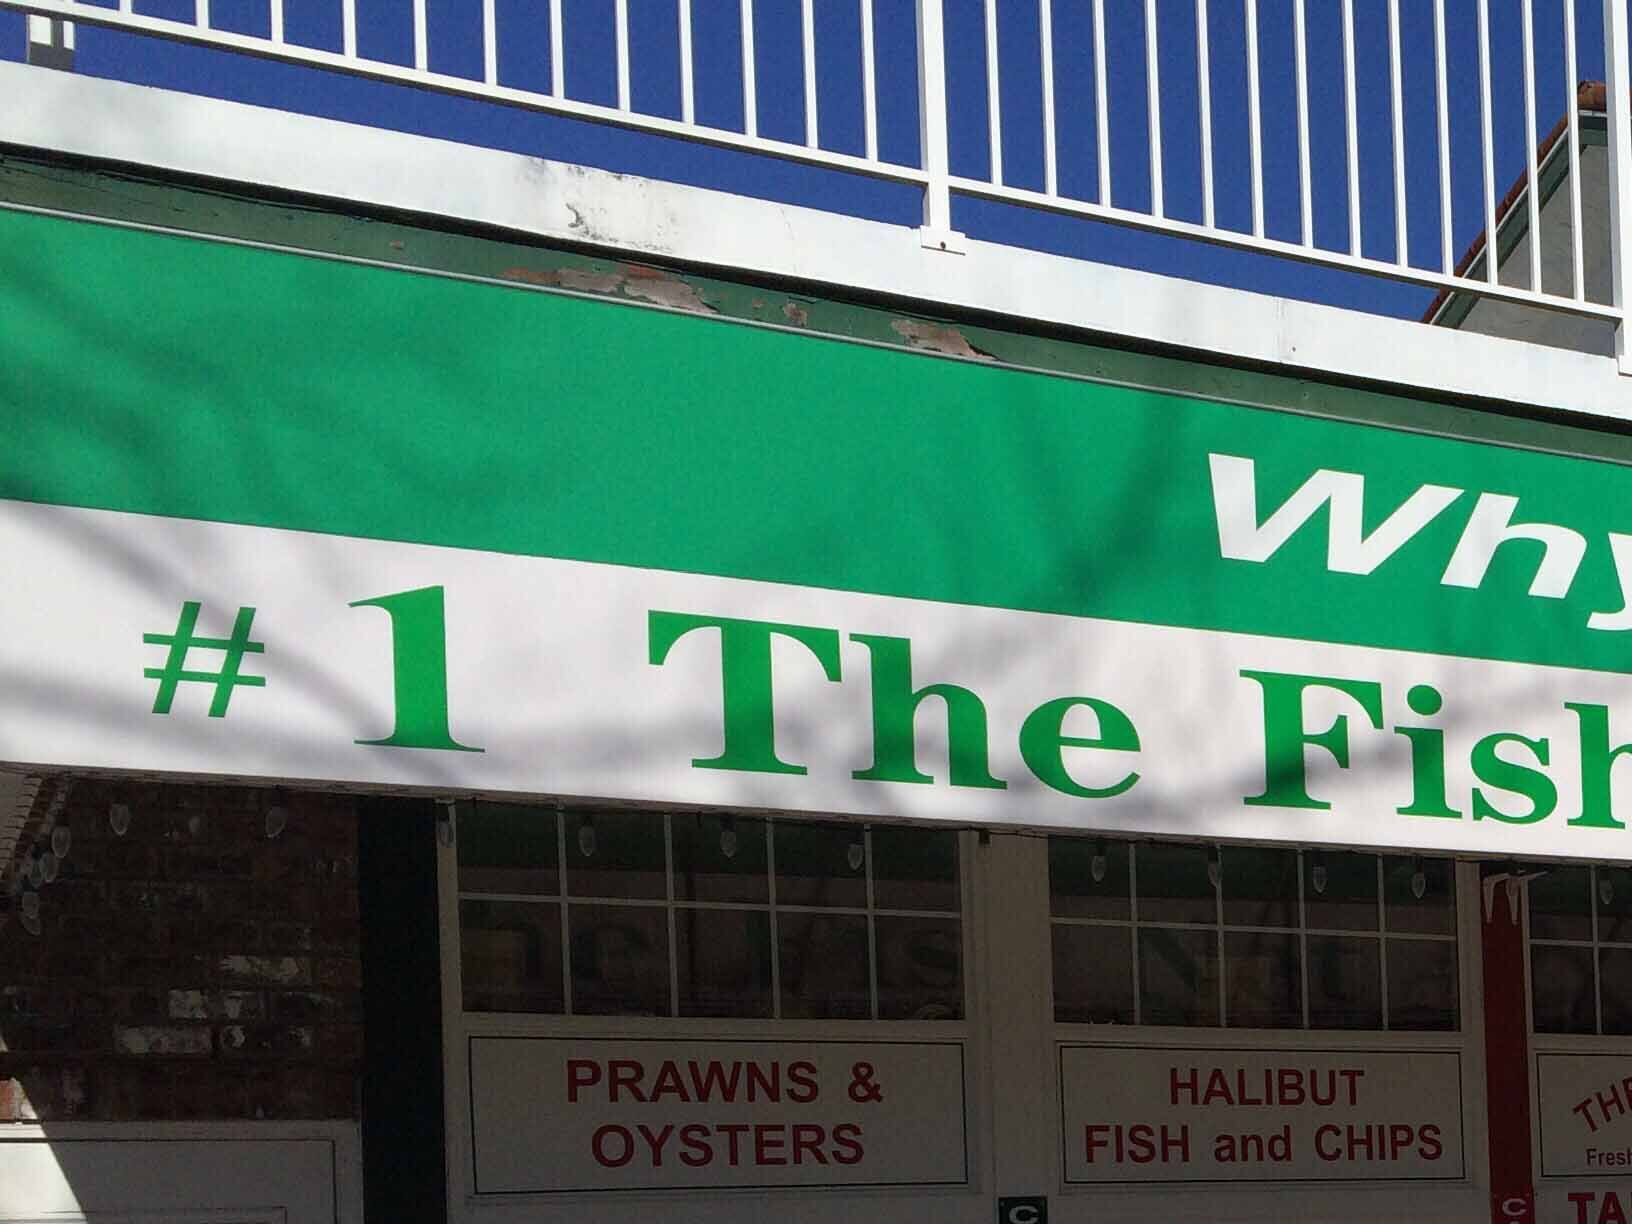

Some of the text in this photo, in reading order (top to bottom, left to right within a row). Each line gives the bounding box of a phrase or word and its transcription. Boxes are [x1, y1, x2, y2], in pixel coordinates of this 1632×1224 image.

[647, 608, 1142, 799] The
[566, 1059, 884, 1104] PRAWNS &
[1169, 1067, 1365, 1106] HALIBUT
[591, 1123, 865, 1168] OYSTERS
[1084, 1123, 1443, 1164] FISH and CHIPS
